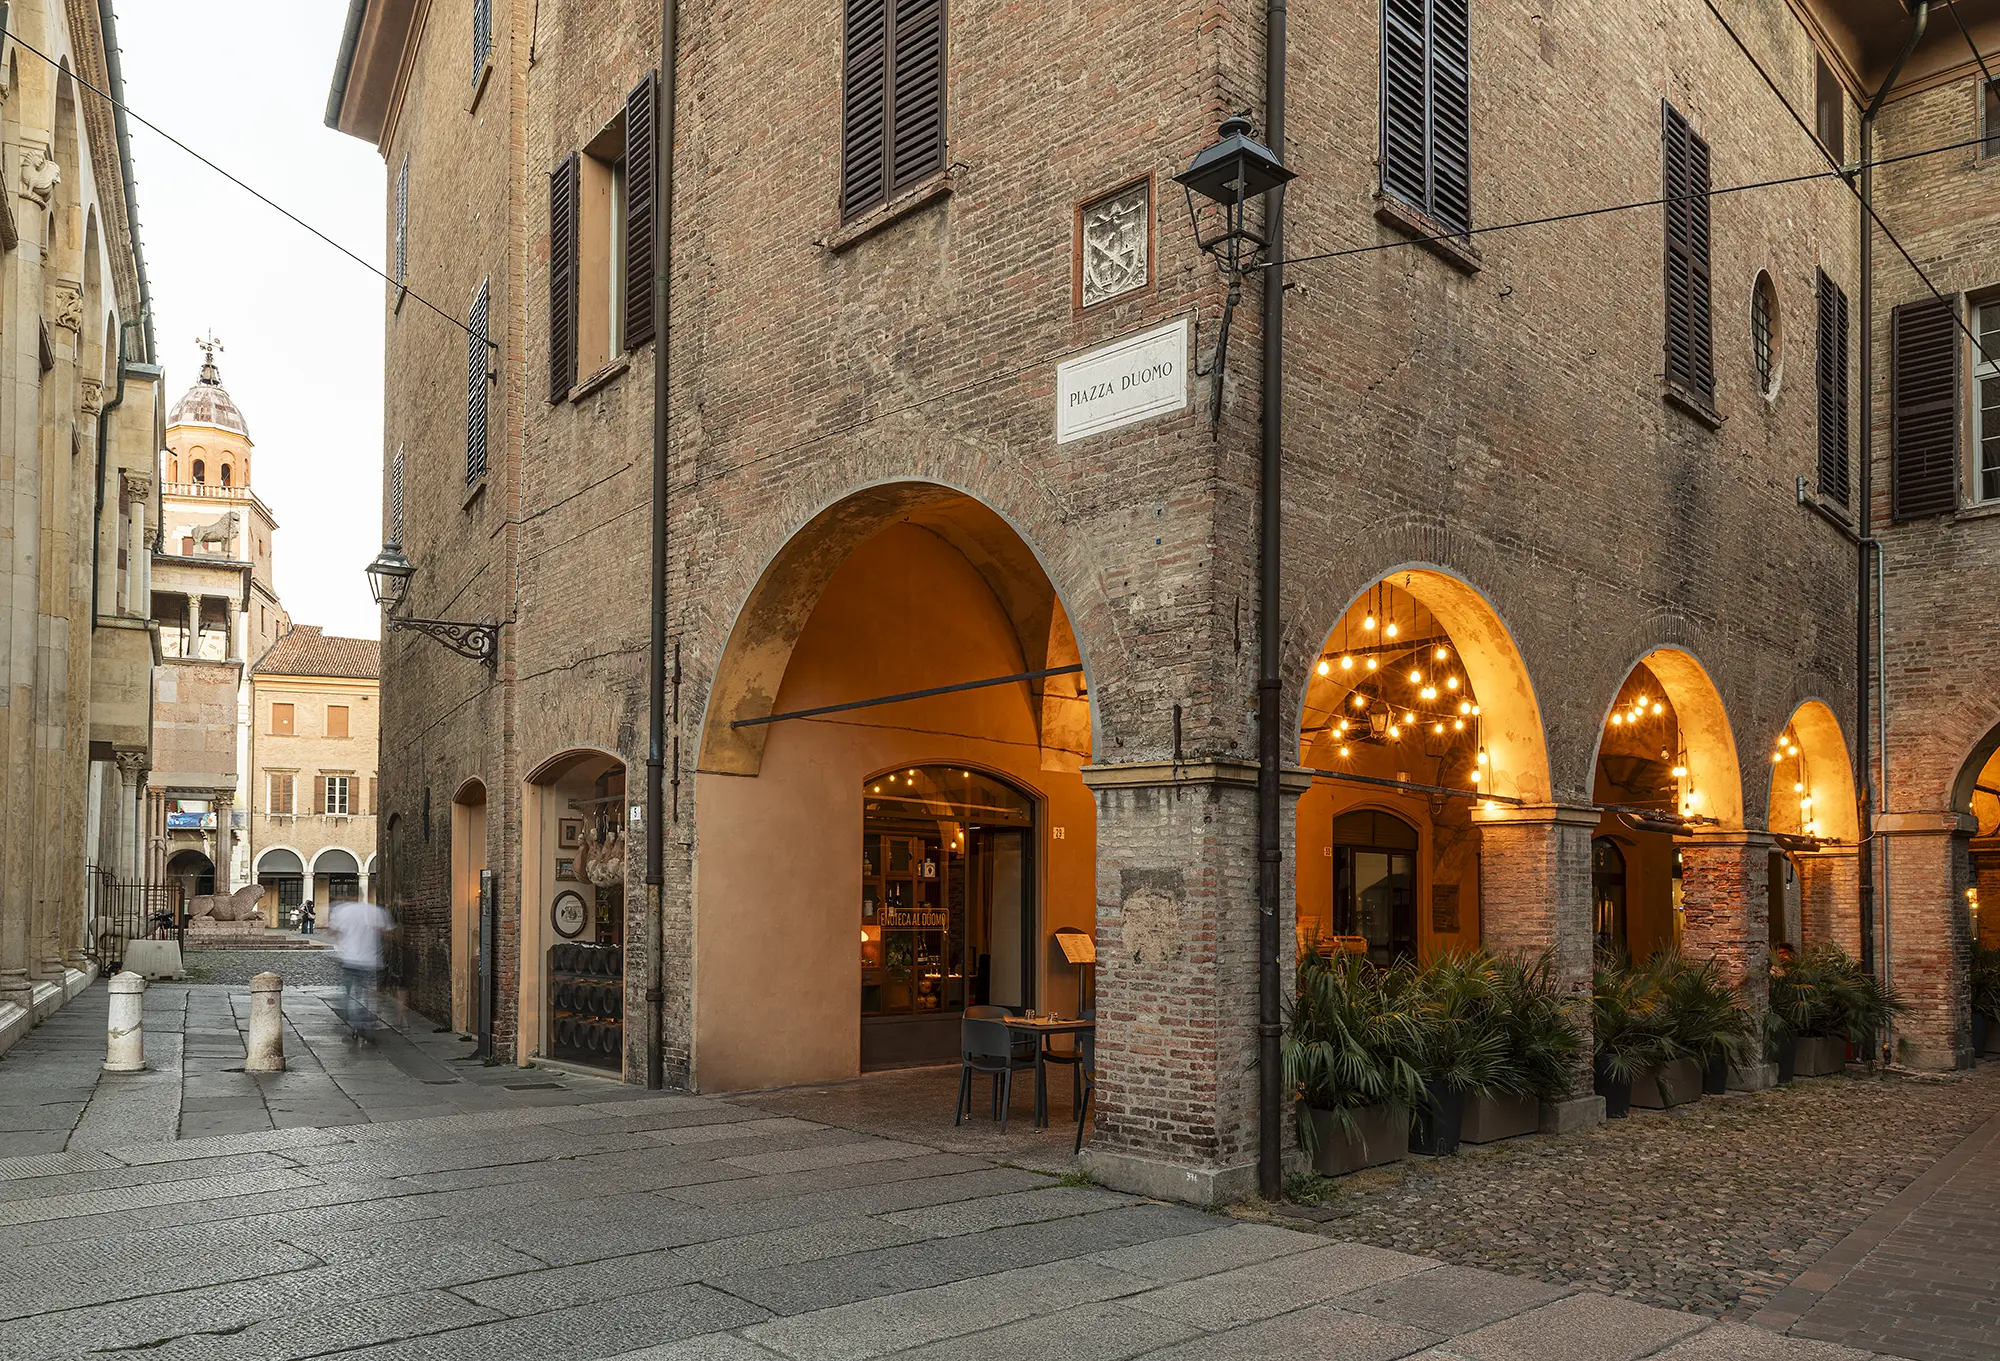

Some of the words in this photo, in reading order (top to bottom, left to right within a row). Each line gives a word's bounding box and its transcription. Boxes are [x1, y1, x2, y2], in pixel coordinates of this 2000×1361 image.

[1069, 381, 1114, 408] PIAZZA
[1120, 361, 1174, 391] DUOMO
[912, 912, 921, 926] AL
